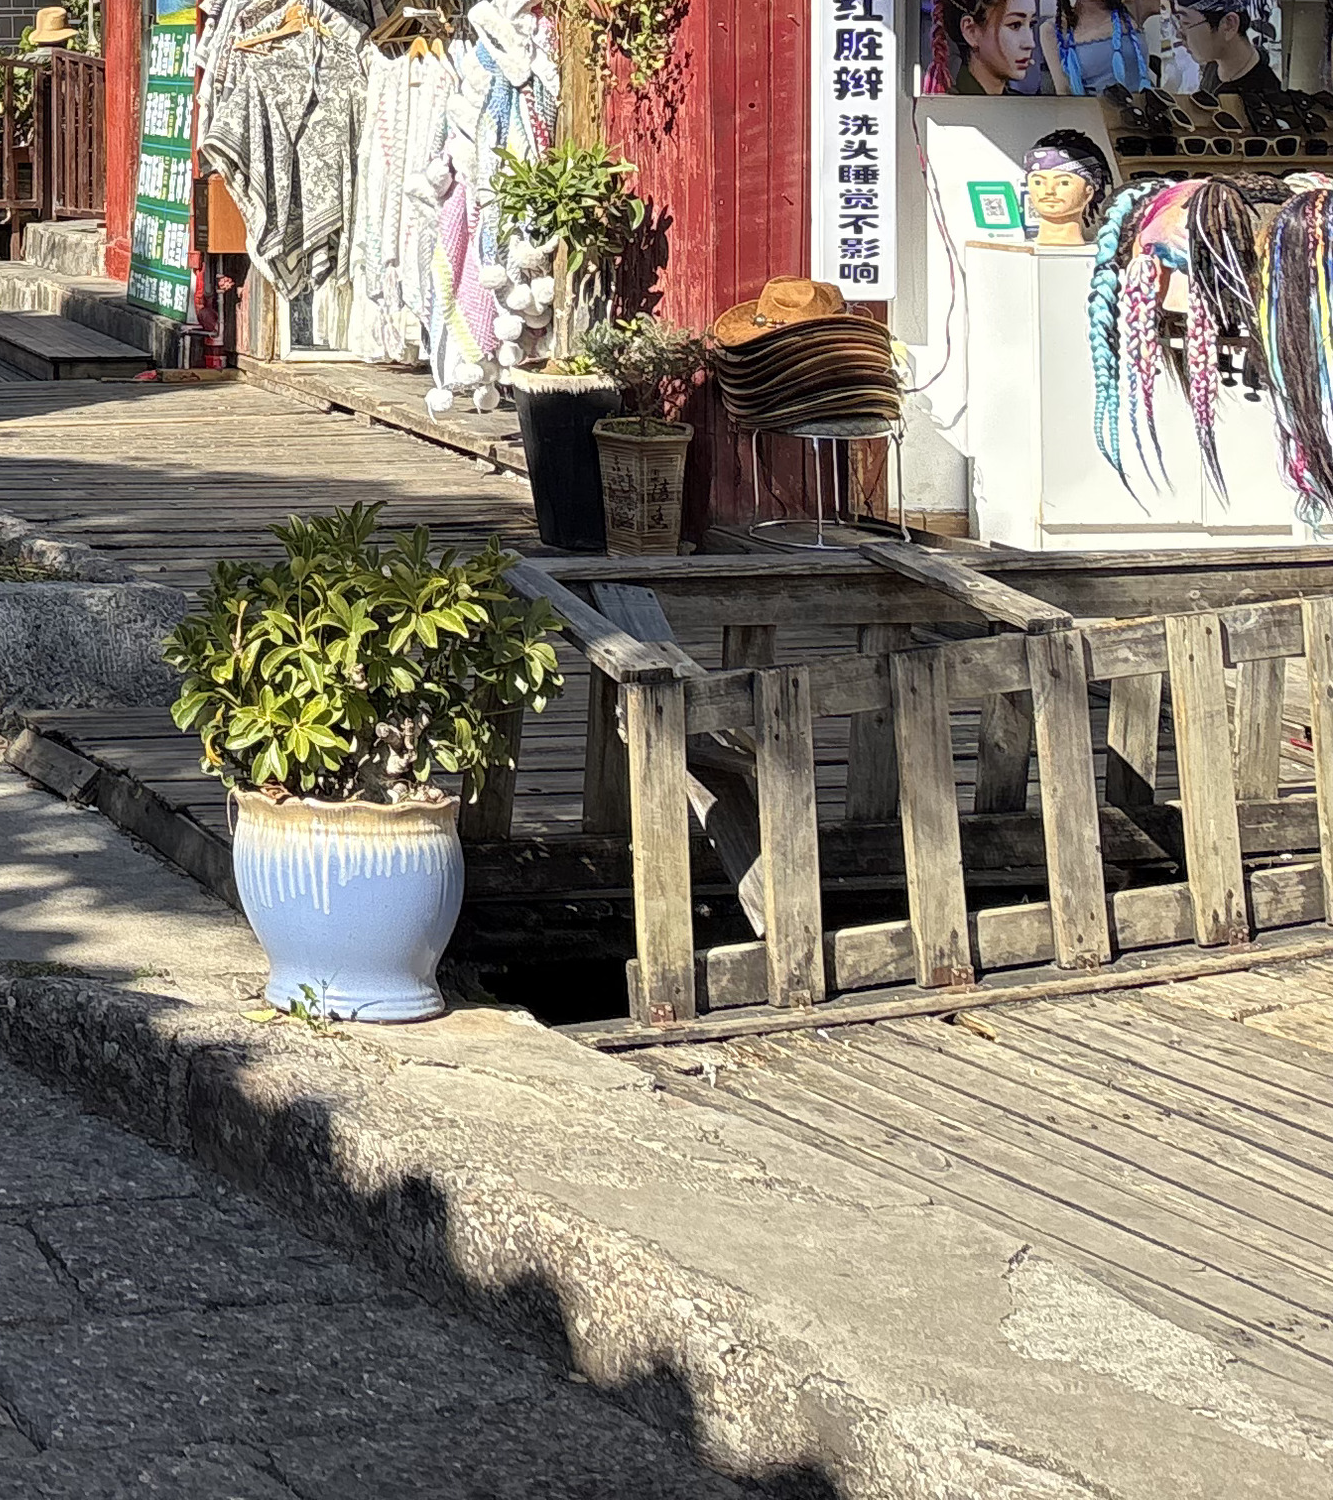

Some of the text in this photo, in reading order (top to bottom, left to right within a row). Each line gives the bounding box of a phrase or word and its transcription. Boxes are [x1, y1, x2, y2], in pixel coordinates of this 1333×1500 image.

[838, 114, 880, 284] 洗头睡觉不影响
